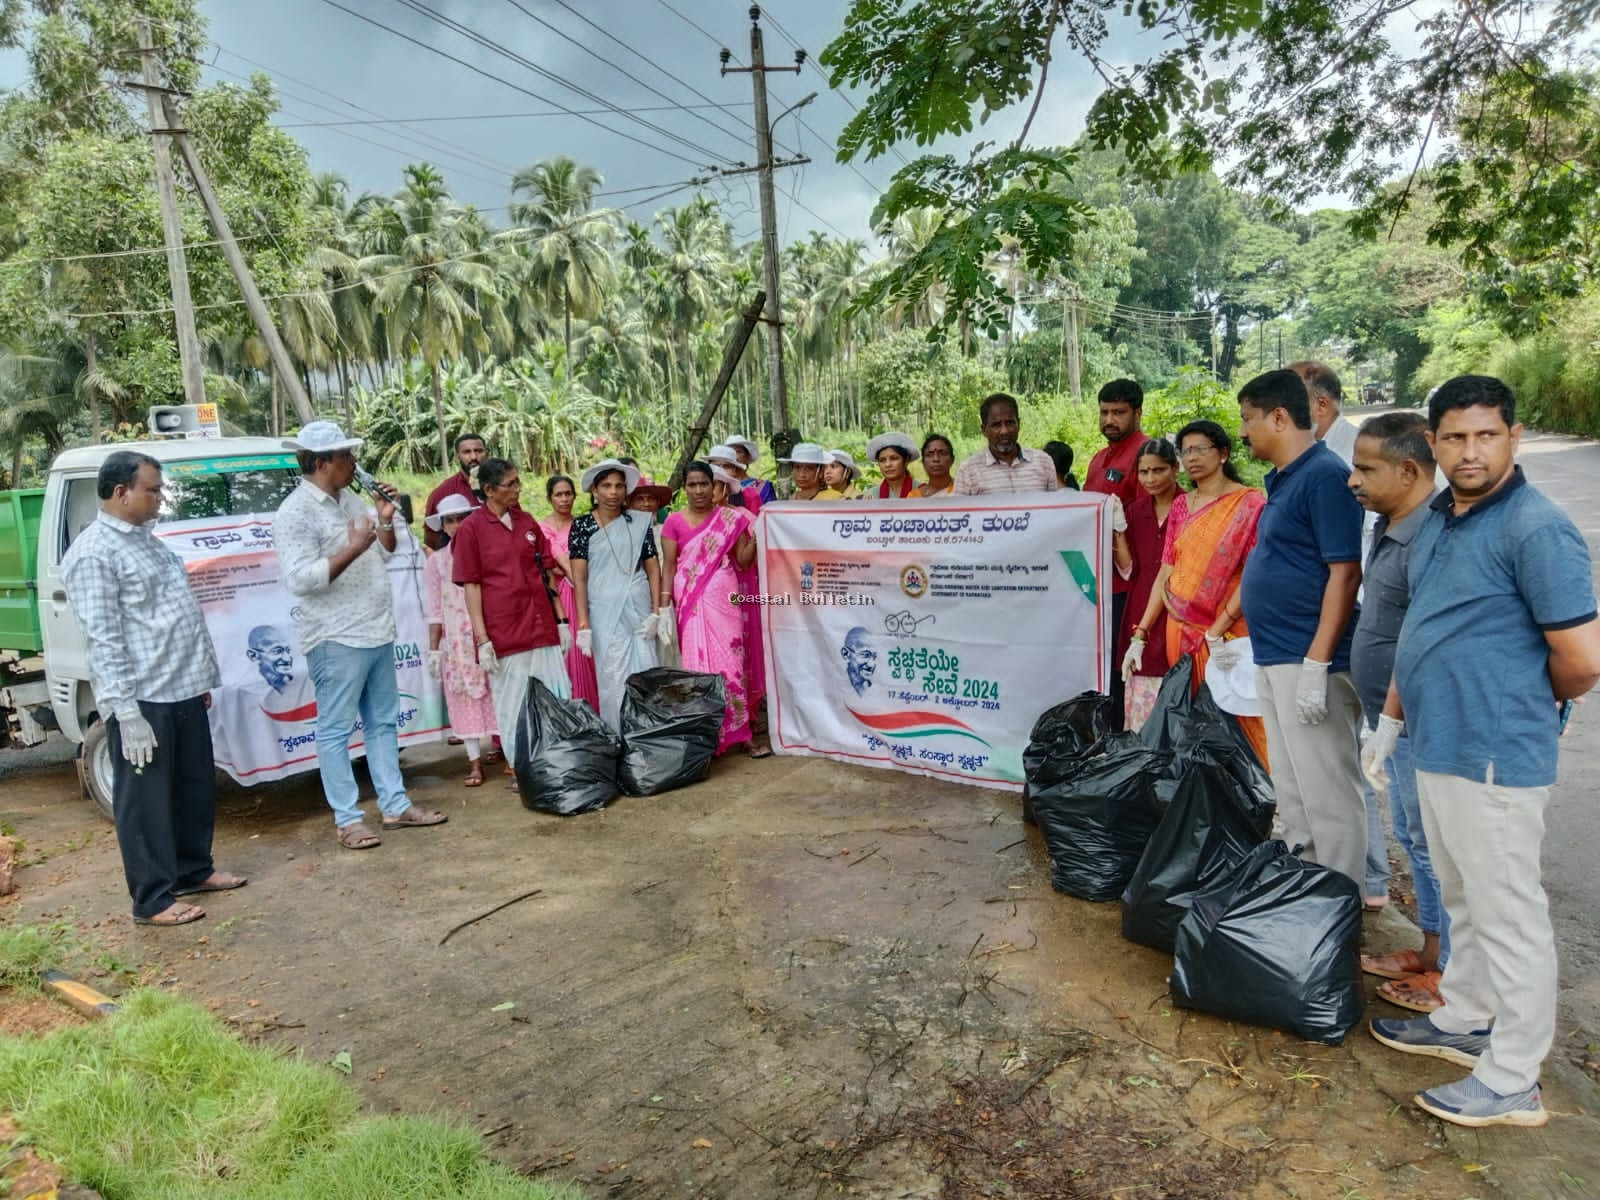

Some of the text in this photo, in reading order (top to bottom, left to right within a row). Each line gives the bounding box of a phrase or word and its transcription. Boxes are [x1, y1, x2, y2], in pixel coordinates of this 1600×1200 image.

[832, 515, 871, 538] ಗ್ರಾಮ
[982, 512, 1030, 532] ತುಂಬೆ
[191, 532, 242, 550] ಗ್ರಾಮ
[395, 642, 420, 660] 024
[922, 671, 999, 700] ಸೇವೆ 2024
[888, 690, 896, 698] 17
[982, 700, 1000, 710] 2024
